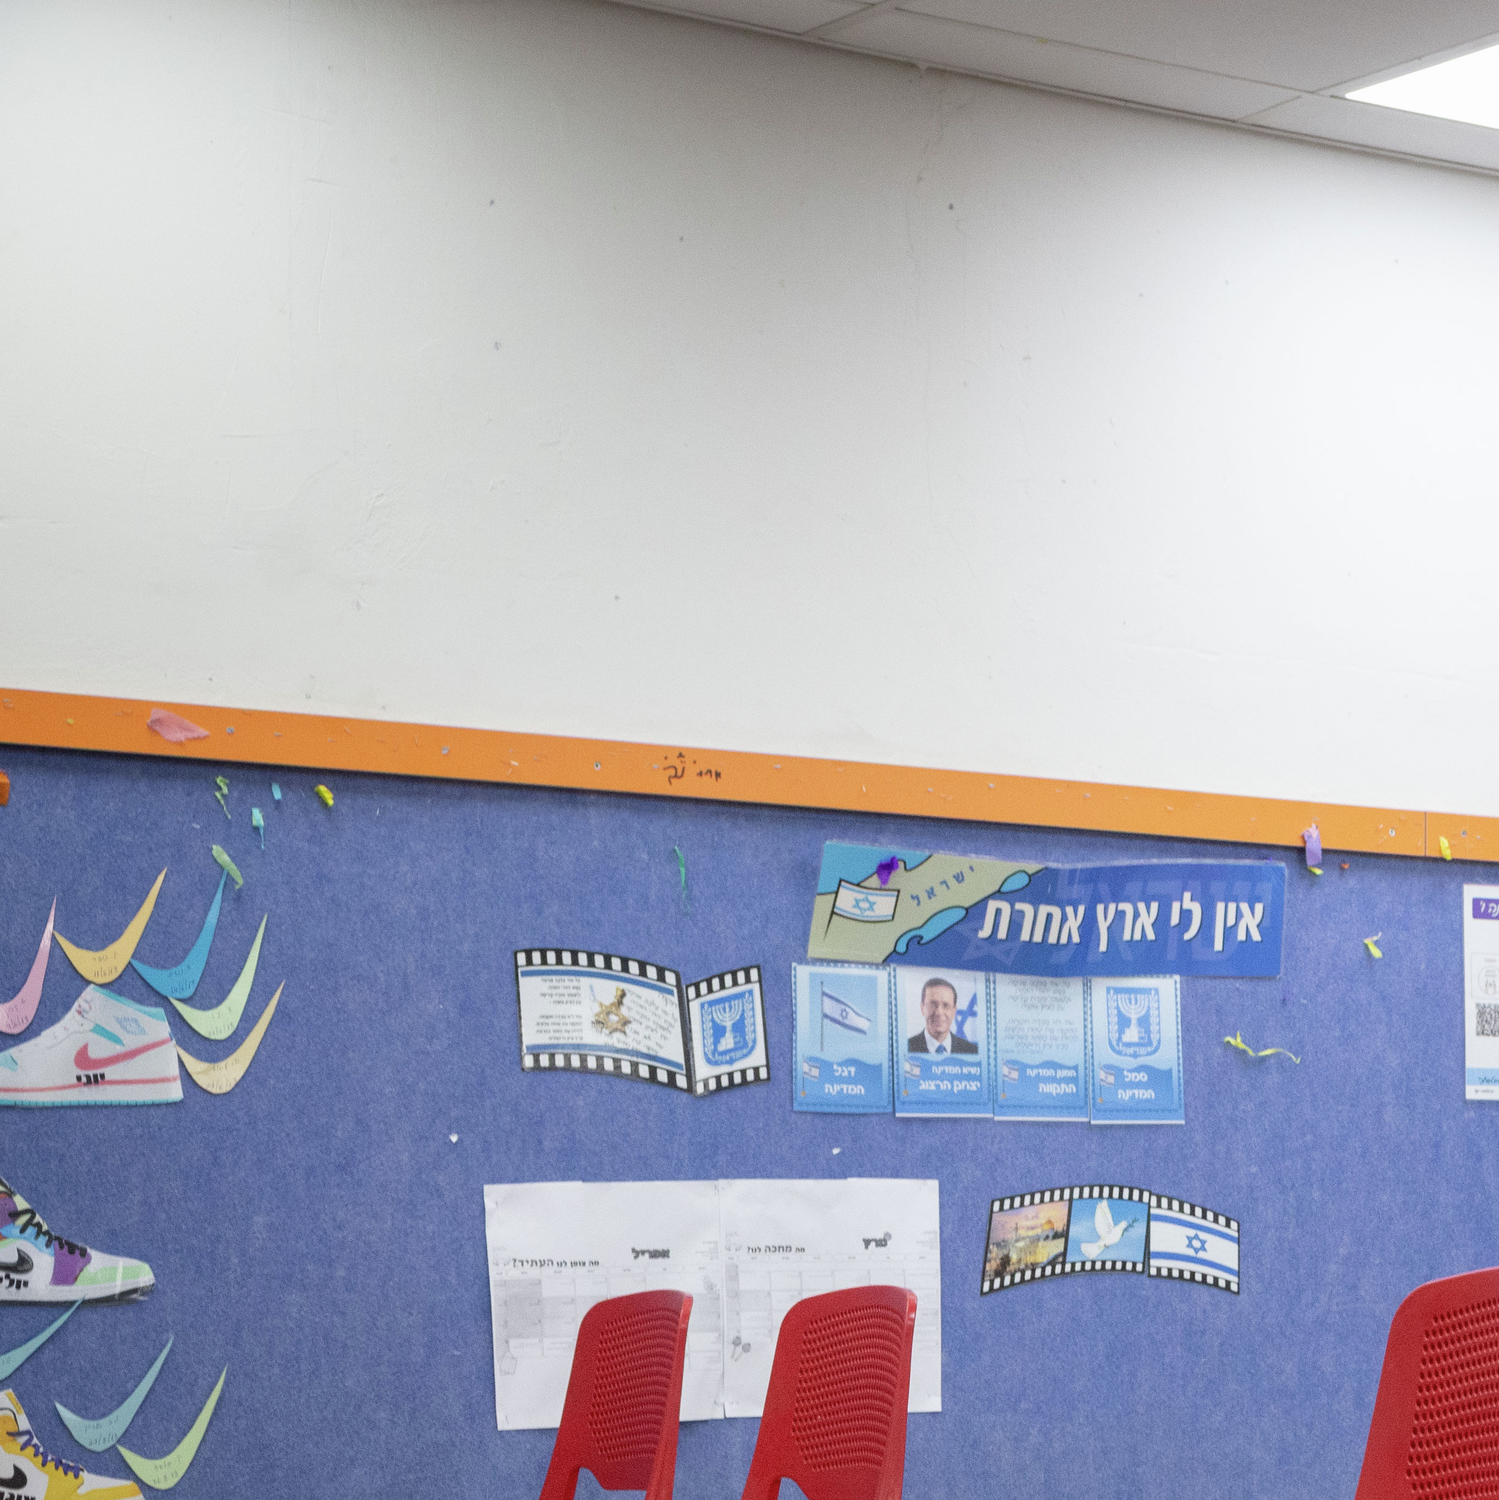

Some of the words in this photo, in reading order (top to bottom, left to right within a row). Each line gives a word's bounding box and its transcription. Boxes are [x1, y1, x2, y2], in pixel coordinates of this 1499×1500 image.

[978, 899, 1085, 945] אחרת
[1170, 891, 1203, 940] לי
[1096, 900, 1160, 952] ארץ
[1214, 899, 1265, 952] אין
[833, 1064, 856, 1078] דגל
[932, 1065, 962, 1075] המדינה
[962, 1065, 981, 1076] נשיא
[1123, 1070, 1148, 1082] סמל
[824, 1083, 865, 1096] המדינה
[919, 1079, 952, 1091] הרצוג
[953, 1081, 981, 1094] יצחק
[1038, 1082, 1077, 1096] התקווה
[1117, 1089, 1156, 1100] המדינה
